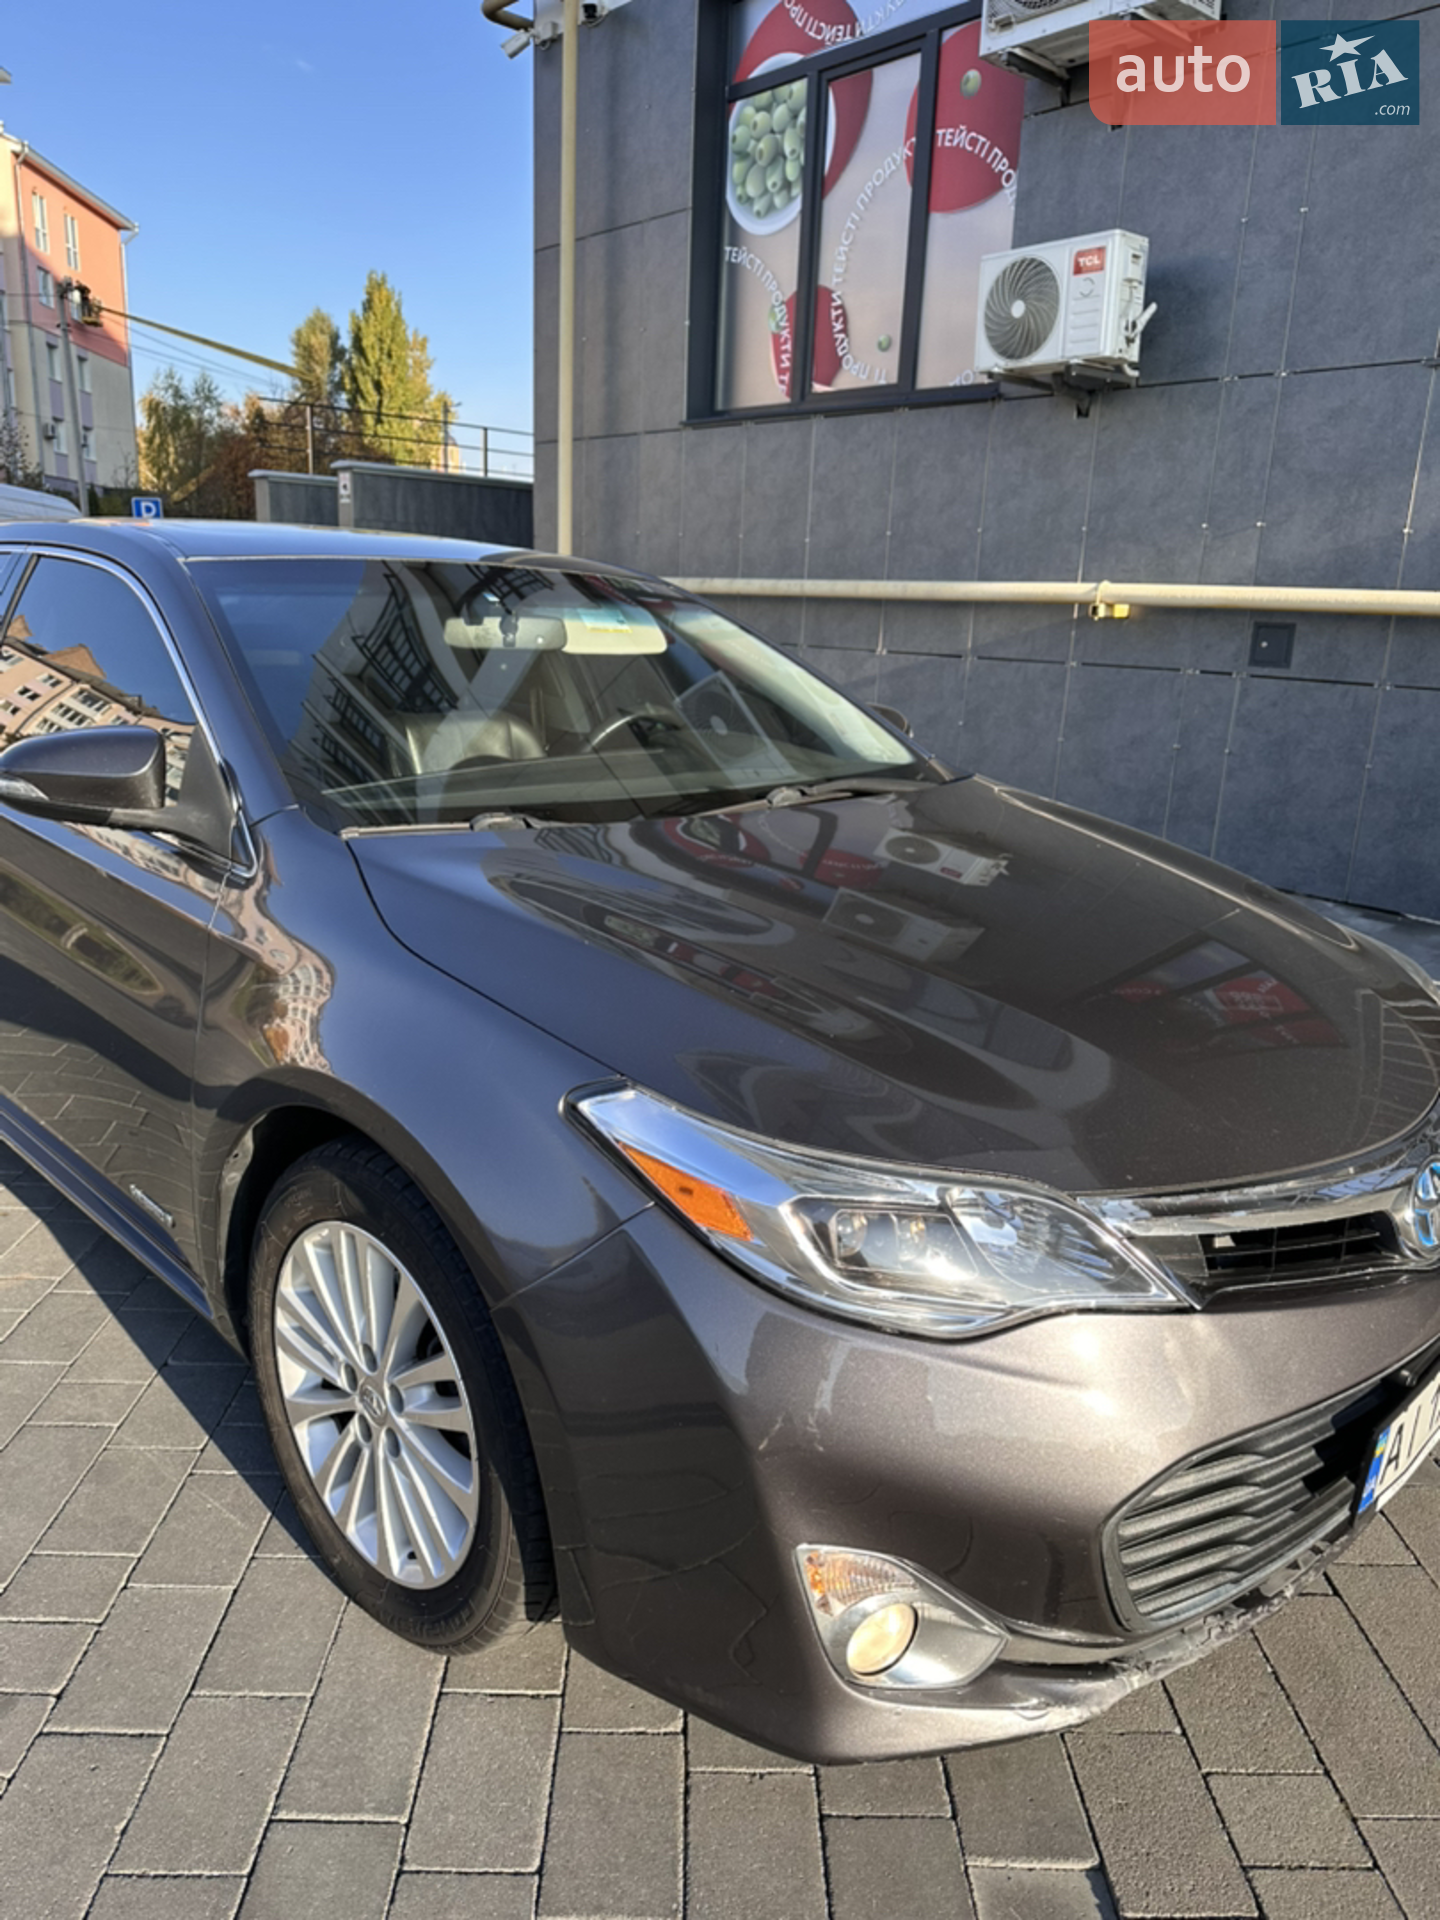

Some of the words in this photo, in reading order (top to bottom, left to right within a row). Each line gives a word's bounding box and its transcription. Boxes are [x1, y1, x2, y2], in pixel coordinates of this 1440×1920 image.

[804, 16, 853, 45] ТЕЙСТІ
[936, 124, 990, 158] ТЕЙСТІ
[832, 211, 861, 286] ТЕЙСТІ
[1077, 254, 1101, 267] TCL
[724, 246, 765, 277] ТЕЙСТІ
[761, 269, 792, 369] ПРОДУКТИ
[831, 290, 871, 381] ПРОДУКТИ
